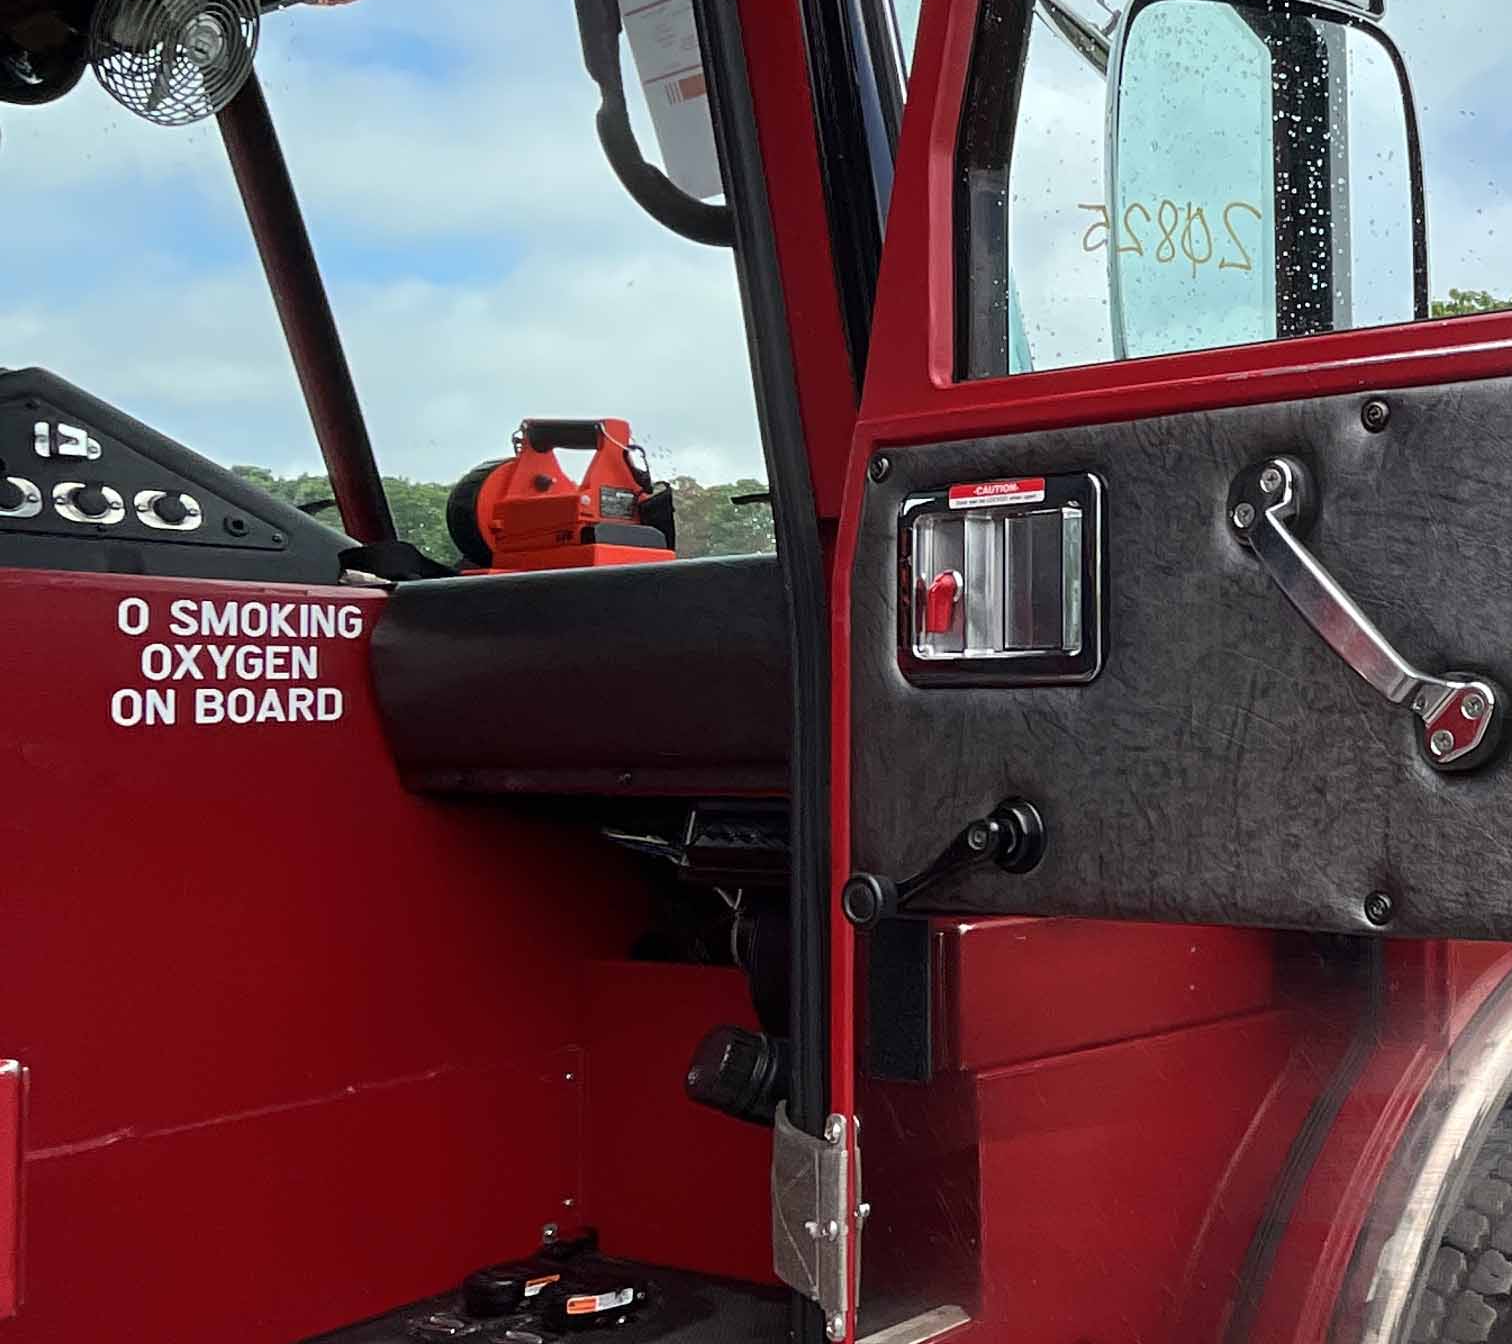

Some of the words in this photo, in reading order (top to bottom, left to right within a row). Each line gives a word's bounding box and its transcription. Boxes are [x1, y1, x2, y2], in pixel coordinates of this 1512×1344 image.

[169, 599, 363, 639] SMOKING
[141, 643, 318, 681] OXYGEN
[111, 688, 176, 727] ON
[195, 688, 344, 724] BOARD
